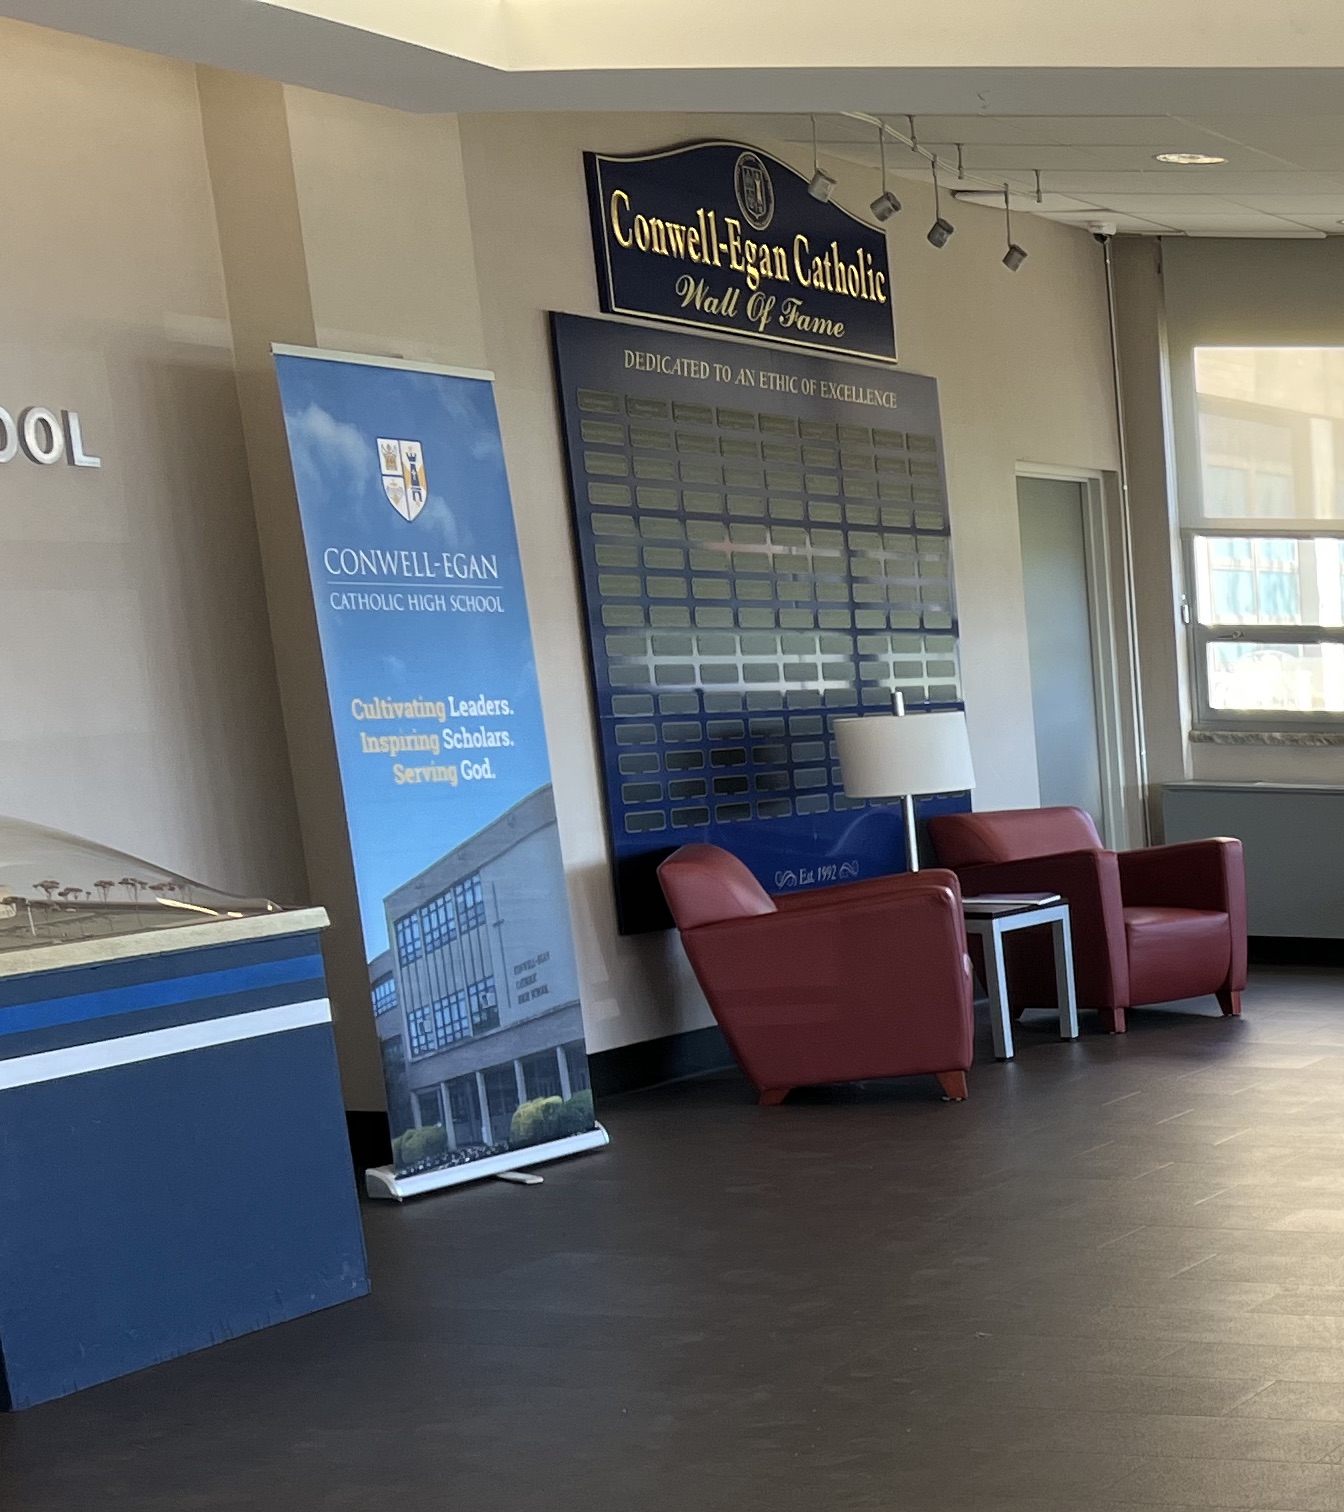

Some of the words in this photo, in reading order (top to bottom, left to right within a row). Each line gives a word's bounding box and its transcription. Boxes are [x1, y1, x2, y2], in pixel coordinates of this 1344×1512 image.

[610, 189, 790, 291] Conwell-Egan
[793, 234, 888, 304] Catholic
[675, 274, 738, 318] Wall
[746, 291, 776, 332] Of
[778, 297, 846, 338] Fame
[624, 349, 711, 380] DEDICATED
[713, 362, 732, 384] TO
[734, 368, 756, 387] AN
[759, 373, 798, 395] ETHIC
[801, 377, 817, 396] OF
[820, 381, 898, 409] EXCELLENCE
[324, 547, 499, 580] CONWELL-EGAN
[330, 592, 404, 612] CATHOLIC
[409, 593, 447, 612] HIGH
[451, 594, 505, 613] SCHOOL
[351, 695, 446, 723] Cultivating
[449, 694, 515, 718] Leaders.
[360, 728, 441, 757] Inspiring
[442, 726, 515, 750] Scholars.
[393, 760, 458, 787] Serving
[460, 757, 497, 781] God.
